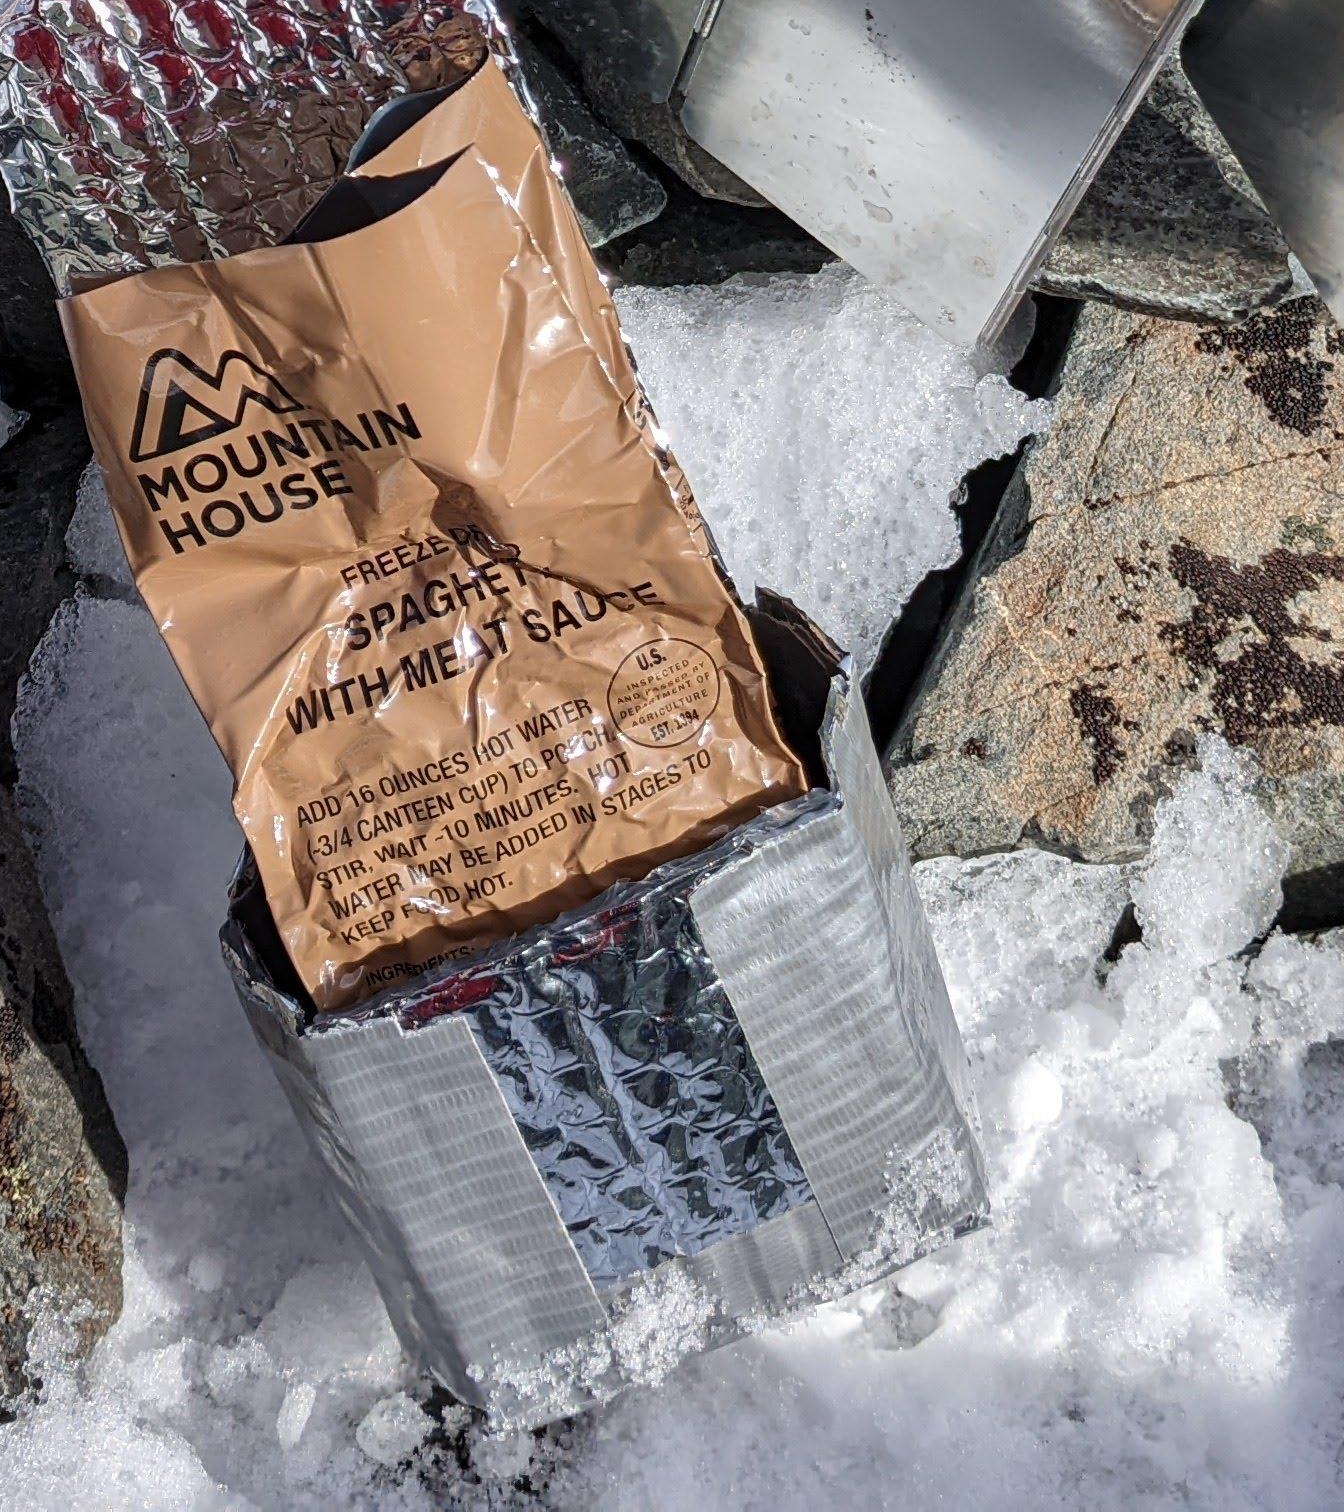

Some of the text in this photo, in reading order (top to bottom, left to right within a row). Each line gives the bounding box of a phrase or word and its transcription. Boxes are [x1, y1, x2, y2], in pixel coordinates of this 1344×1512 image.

[137, 402, 422, 512] MOUNTAIN
[159, 460, 353, 555] HOUSE
[340, 536, 449, 589] FREEZE
[286, 581, 666, 735] WITH MEAT SAUCE
[626, 659, 689, 691] INSPECTED
[635, 648, 667, 671] U.S.
[696, 671, 710, 684] OF
[617, 692, 641, 705] AND
[632, 688, 708, 727] AGRICULTURE
[297, 698, 593, 829] ADD 16 OUNCES HOT WATER
[357, 791, 455, 842] CANTEEN
[458, 770, 509, 804] CUP)
[509, 757, 538, 784] TO
[316, 859, 374, 889] STIR,
[374, 834, 428, 864] WAIT
[474, 779, 579, 833] MINUTES.
[587, 751, 630, 789] HOT
[328, 748, 712, 920] WATER MAY BE ADDED IN STAGES TO
[340, 910, 395, 946] KEEP
[463, 871, 513, 901] HOT.
